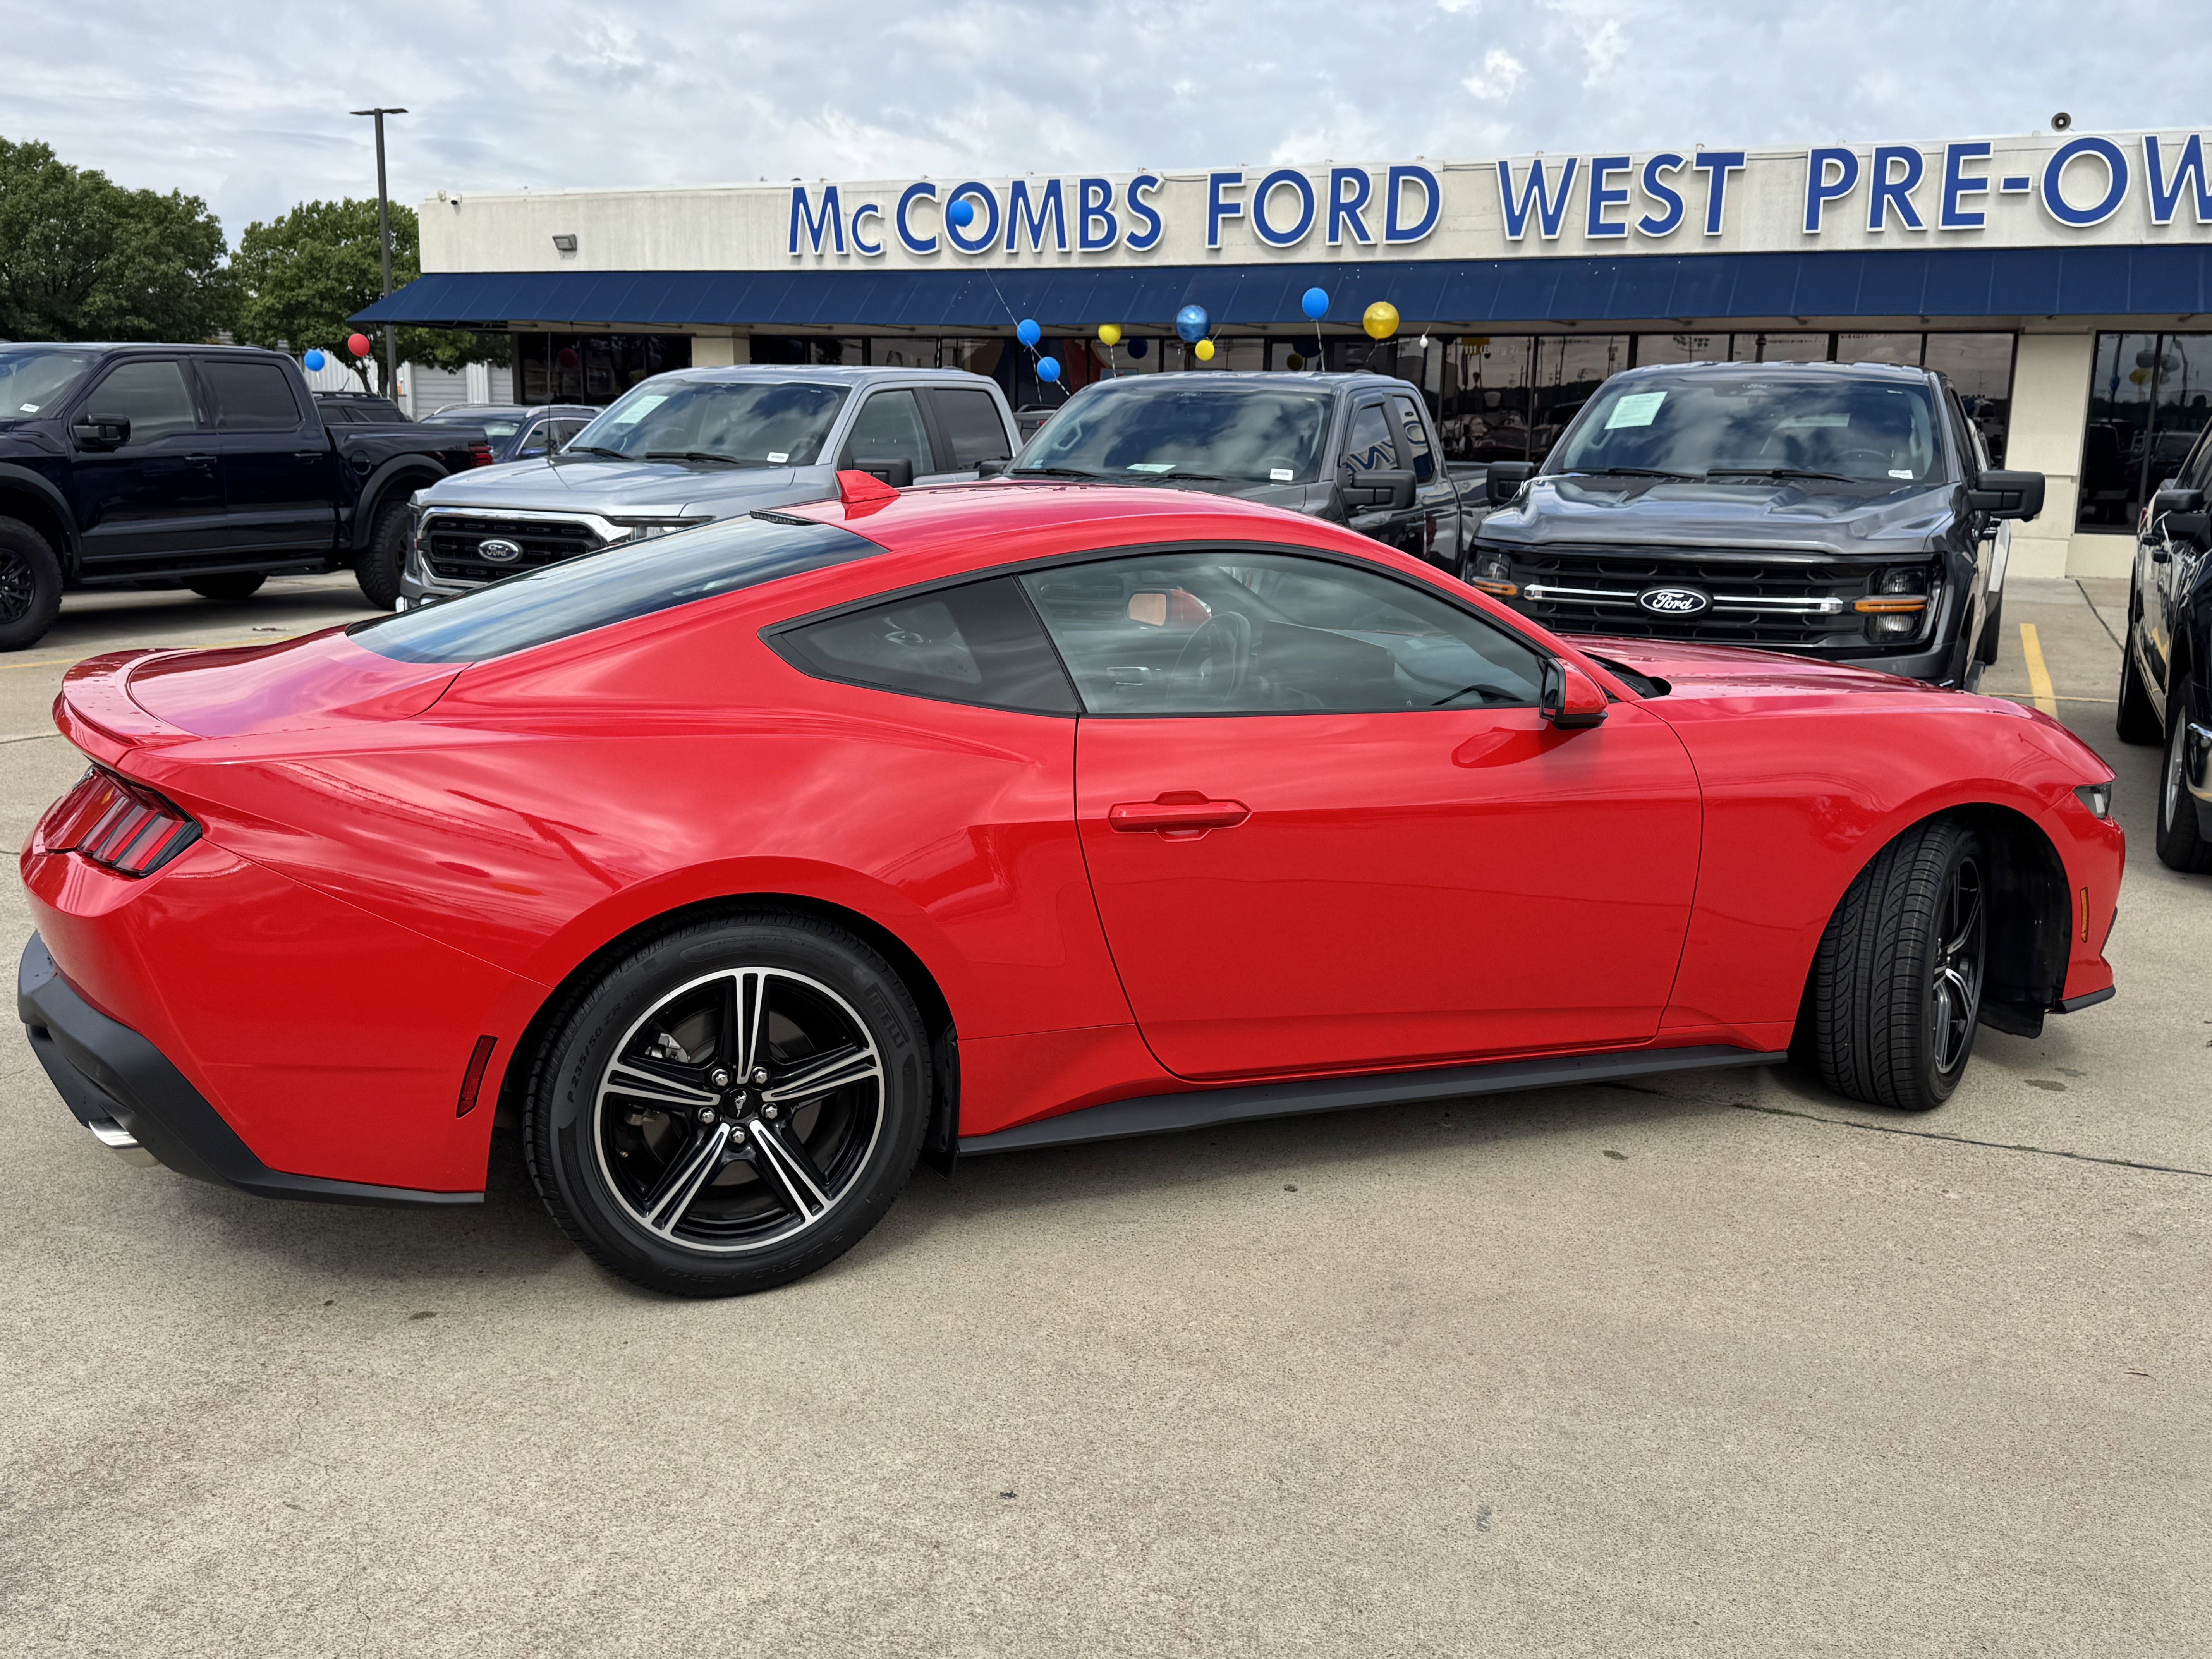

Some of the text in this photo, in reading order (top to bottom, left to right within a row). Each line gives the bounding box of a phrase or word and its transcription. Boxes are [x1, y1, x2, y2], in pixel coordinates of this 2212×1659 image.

[1205, 165, 1442, 249] FORD
[1496, 151, 1746, 239] WEST
[1803, 133, 2212, 234] PRE-OW
[487, 544, 508, 556] Ford
[1652, 592, 1694, 610] Ford
[863, 981, 910, 1049] PIRELLI
[572, 1026, 603, 1088] 235/50
